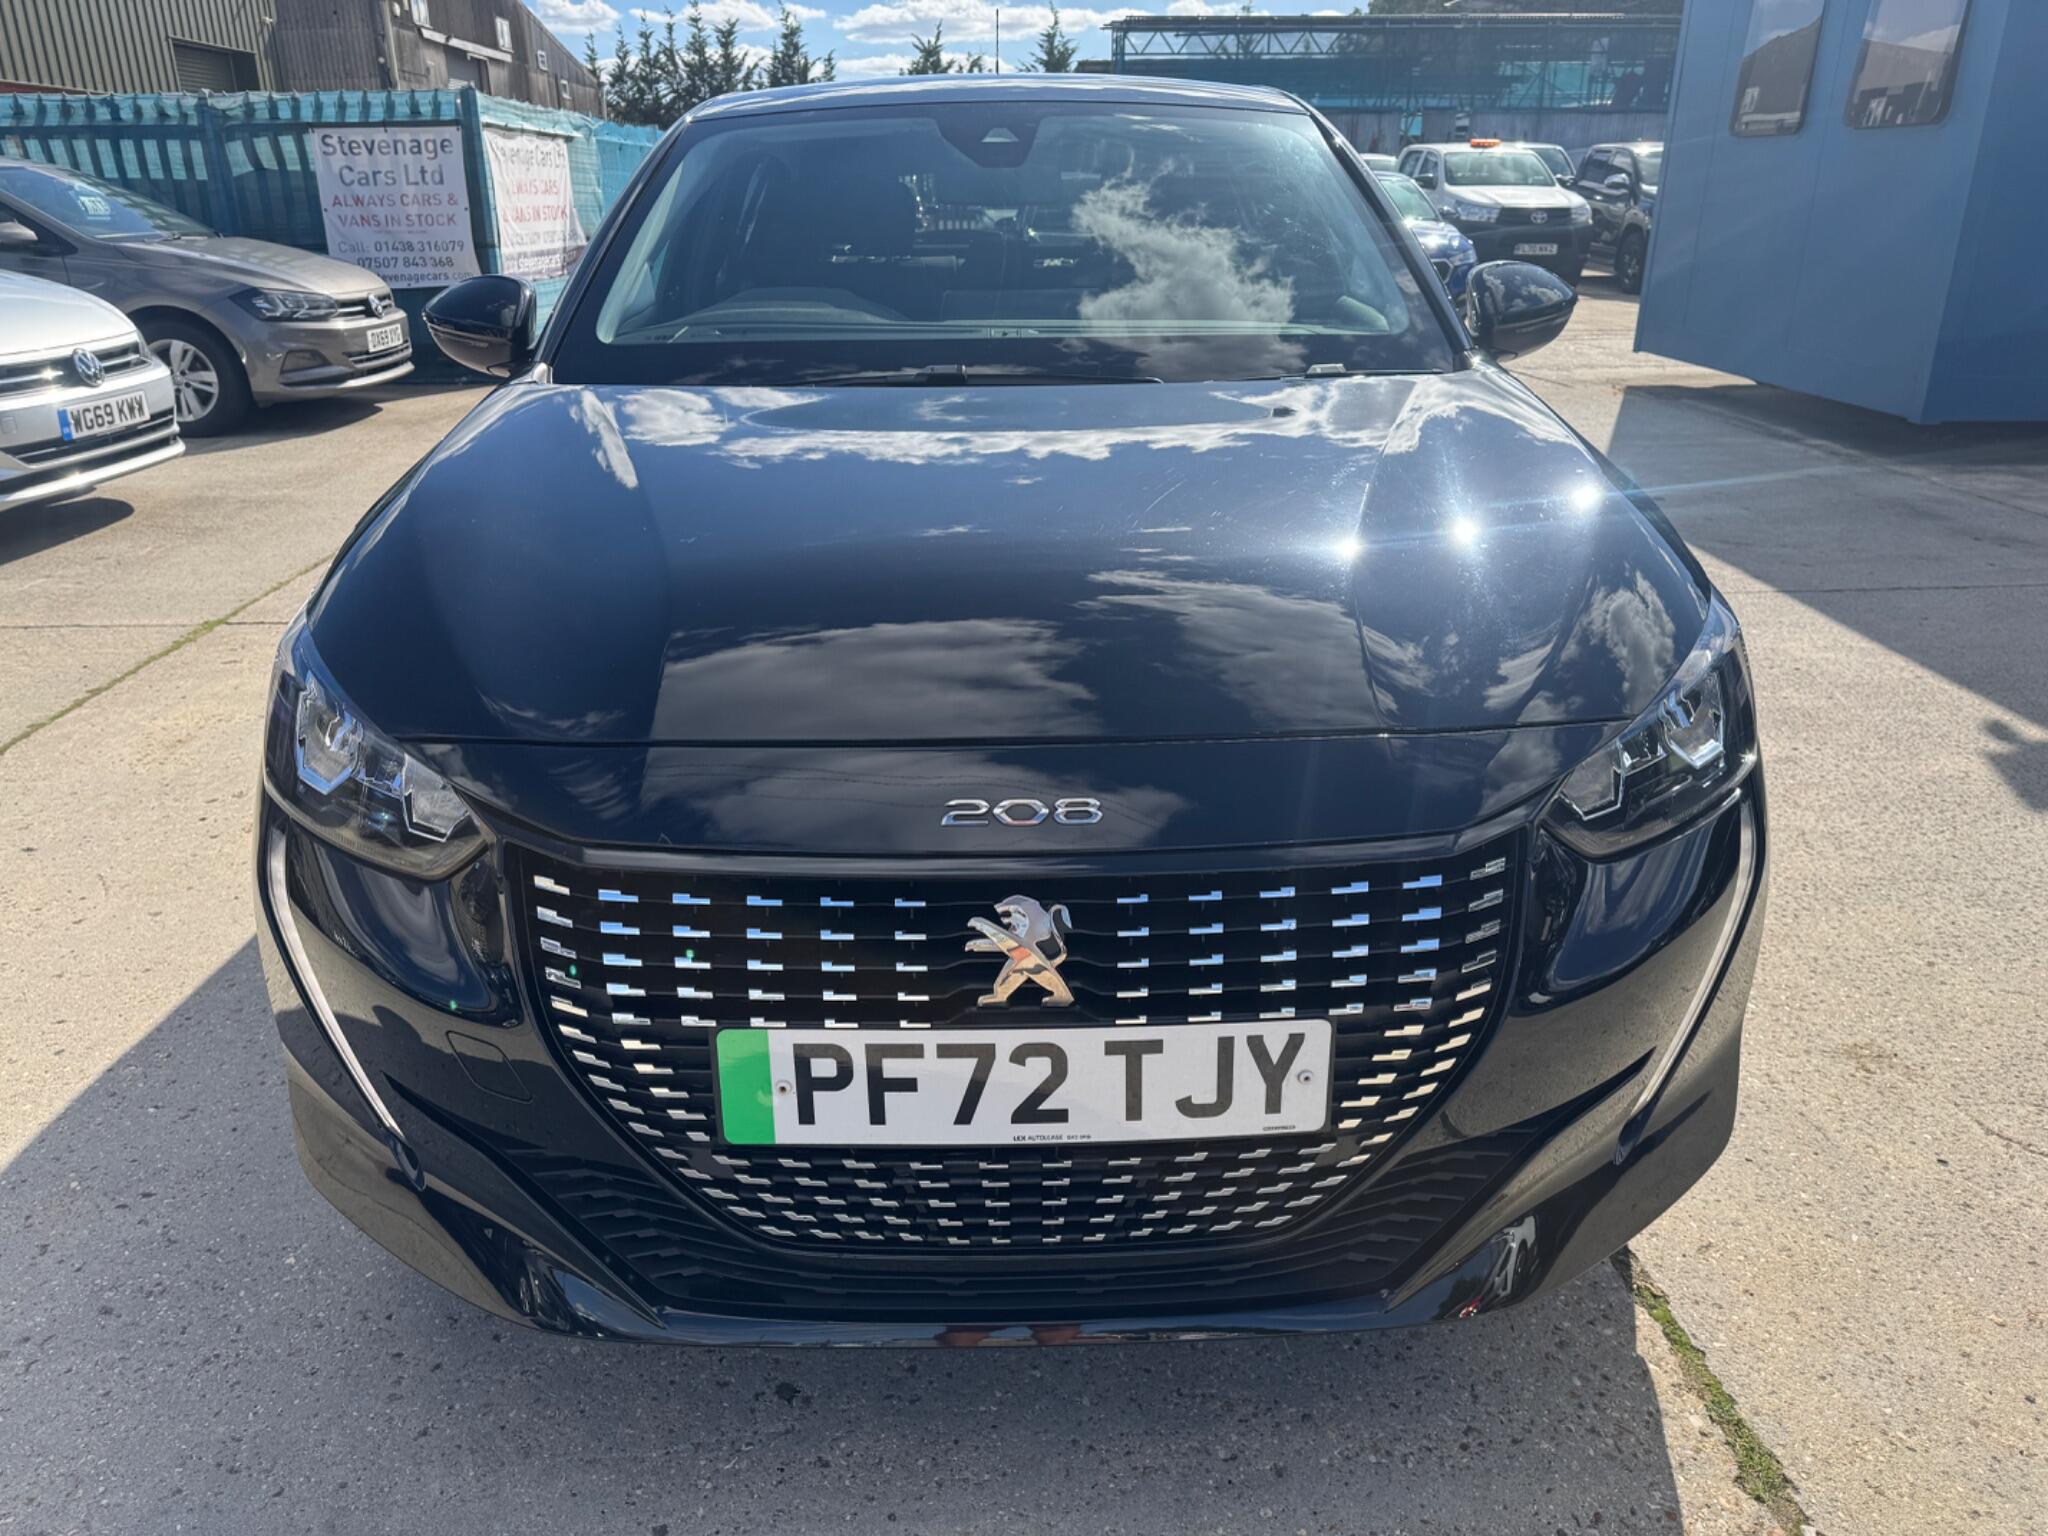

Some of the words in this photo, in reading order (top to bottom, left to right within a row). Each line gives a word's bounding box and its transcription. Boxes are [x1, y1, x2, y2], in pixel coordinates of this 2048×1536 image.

[321, 134, 453, 160] Stevenage
[339, 165, 397, 187] Cars
[404, 164, 444, 186] Ltd
[332, 194, 396, 208] ALWAYS
[400, 193, 442, 207] CARS
[447, 193, 460, 206] &
[338, 214, 381, 228] VANS
[385, 213, 402, 227] IN
[405, 213, 457, 227] STOCK
[338, 241, 369, 254] Call:
[374, 240, 415, 253] 01438
[417, 240, 465, 252] 316079
[357, 256, 398, 269] 07507
[402, 256, 428, 268] 843
[430, 256, 454, 268] 368
[376, 271, 474, 283] tevenagecars.com
[70, 402, 115, 433] WG69
[941, 797, 1103, 826] 208
[793, 1041, 1069, 1126] PF72
[1104, 1033, 1306, 1122] TJY
